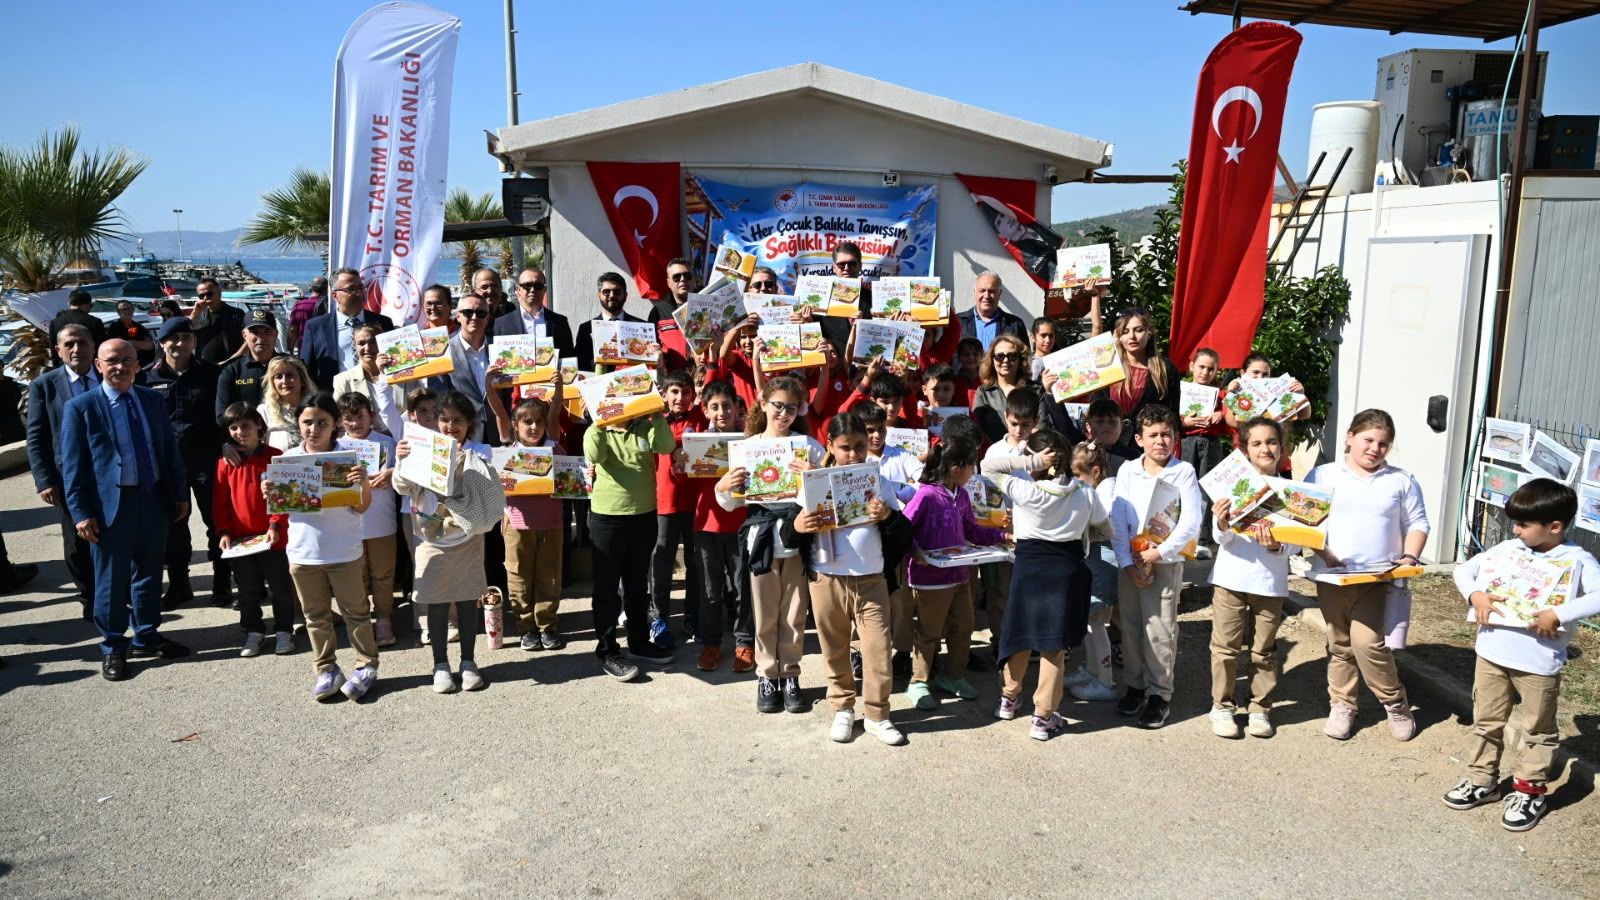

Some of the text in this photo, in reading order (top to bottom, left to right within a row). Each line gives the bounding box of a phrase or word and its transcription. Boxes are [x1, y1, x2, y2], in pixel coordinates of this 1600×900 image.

[392, 52, 422, 258] ORMAN BAKANLIĞI
[366, 113, 389, 255] T.C. TARIM VE
[750, 216, 909, 241] Her Çocuk Balıkla Tanışsın,
[765, 233, 823, 260] Sağlıklı
[280, 471, 306, 479] Sporcu
